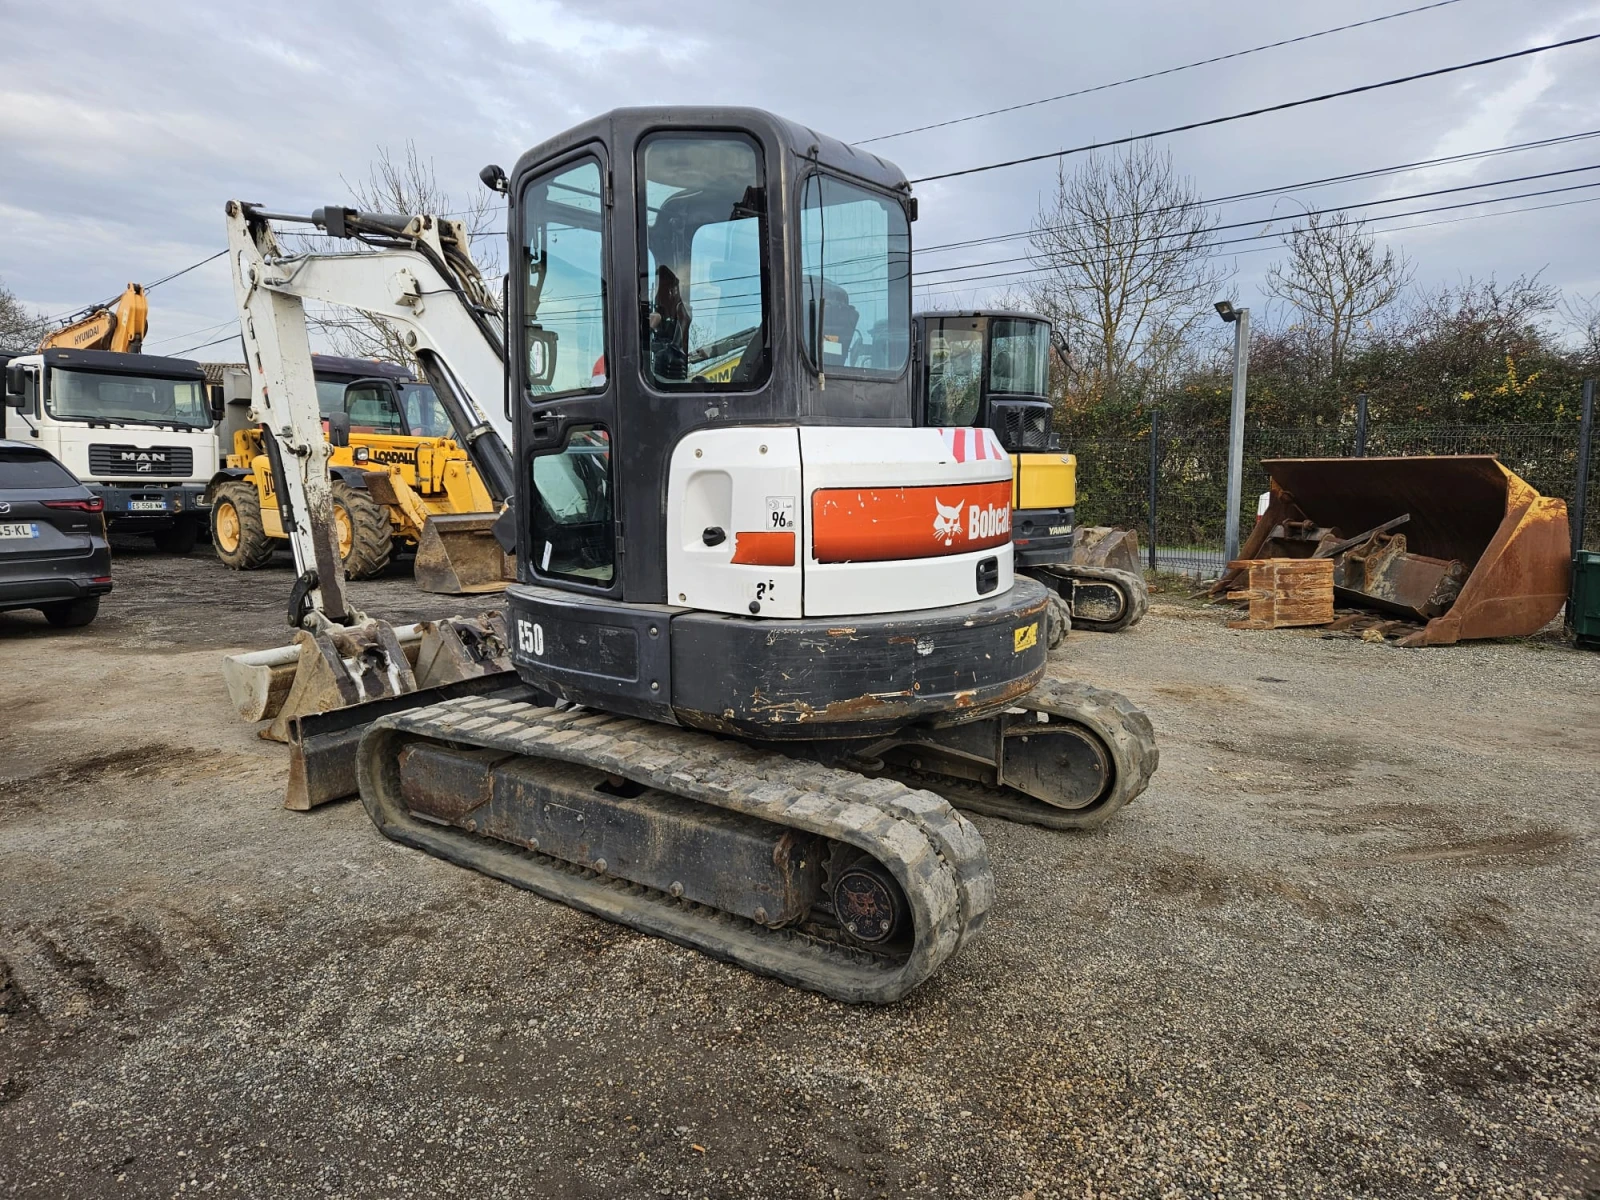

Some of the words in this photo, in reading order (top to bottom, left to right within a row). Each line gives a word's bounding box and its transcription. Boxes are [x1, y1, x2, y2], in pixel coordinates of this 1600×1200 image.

[74, 325, 100, 345] HYUNDAI
[121, 452, 166, 462] MAN
[373, 450, 417, 464] LOADALL
[772, 511, 786, 528] 96
[968, 501, 1010, 540] Bobcat
[0, 525, 30, 536] 5-KL
[517, 619, 544, 656] E50
